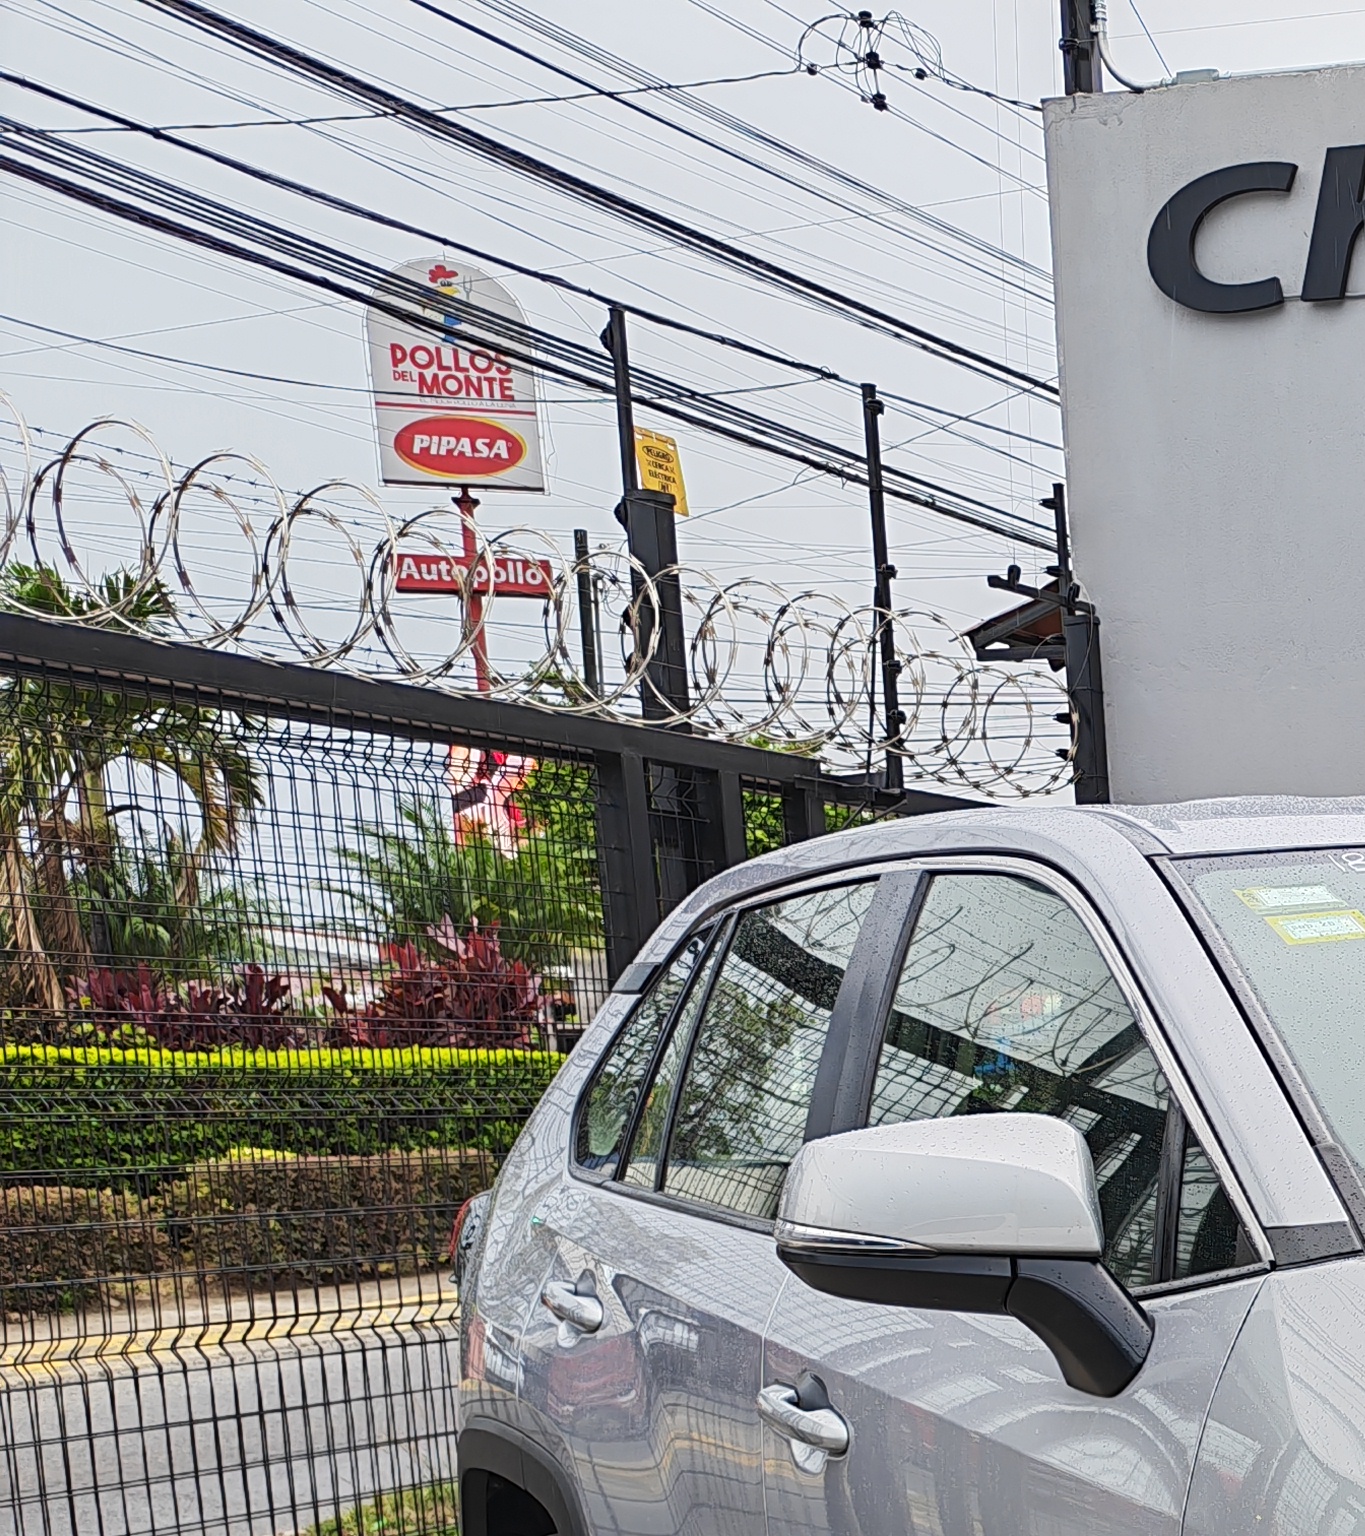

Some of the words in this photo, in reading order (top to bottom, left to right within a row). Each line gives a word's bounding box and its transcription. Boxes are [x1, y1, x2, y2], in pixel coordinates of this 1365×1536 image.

[390, 343, 512, 376] POLLOS
[392, 370, 417, 382] DEL
[418, 372, 515, 402] MONTE
[412, 434, 509, 459] PIPASA
